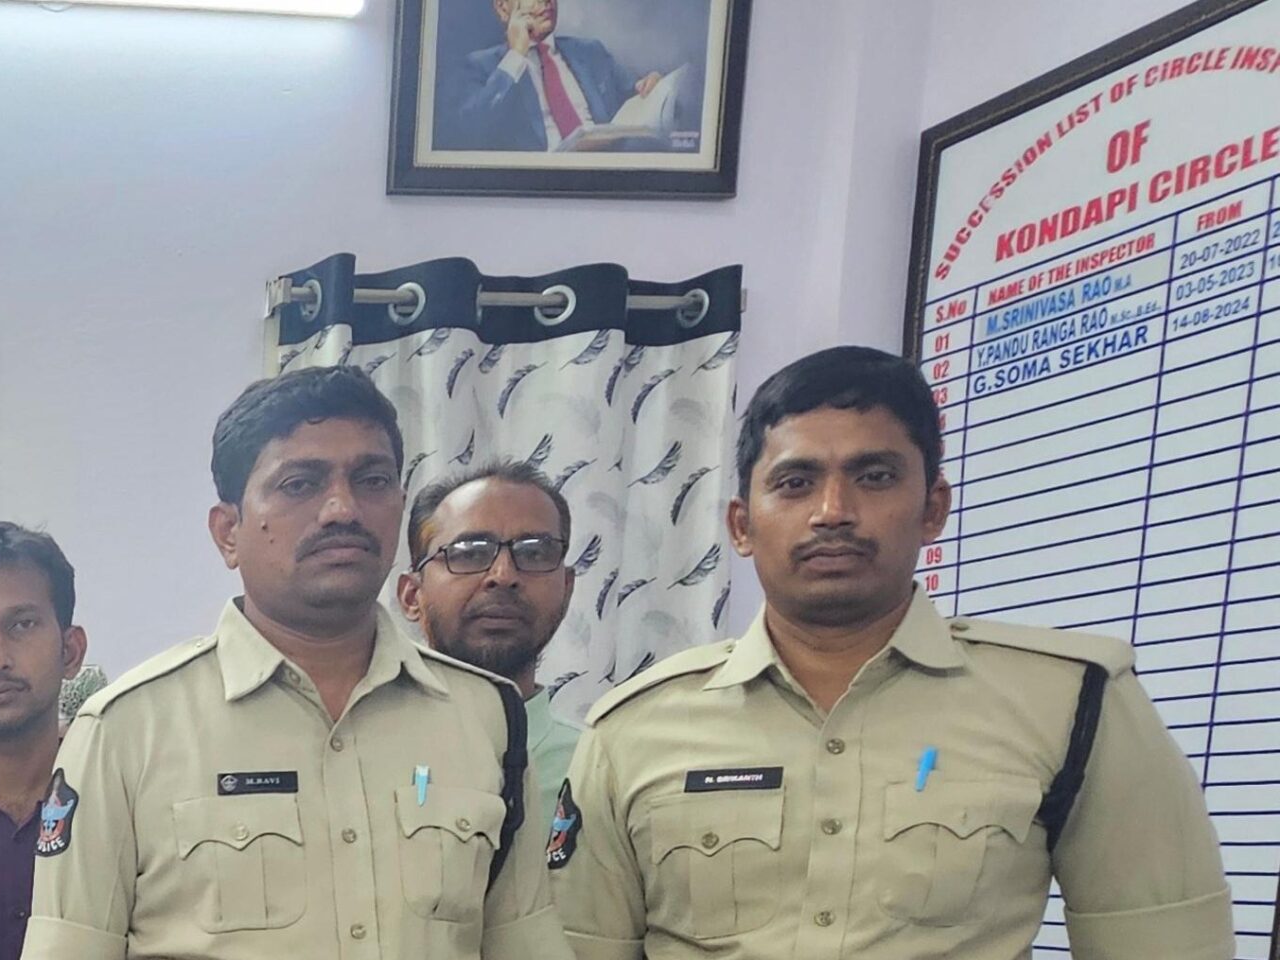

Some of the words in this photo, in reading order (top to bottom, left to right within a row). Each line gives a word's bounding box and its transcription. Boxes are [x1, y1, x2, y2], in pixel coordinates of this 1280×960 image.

[933, 132, 1054, 281] SUCCESSION
[1055, 92, 1104, 138] LIST
[1109, 73, 1140, 104] OF
[1143, 47, 1231, 87] CIRCLE
[995, 181, 1140, 263] KONDAPI
[1148, 125, 1280, 205] CIRCLE
[1106, 119, 1152, 174] OF
[934, 333, 950, 354] 01
[985, 291, 1077, 336] M.SRINIVASA
[1081, 275, 1112, 305] RAO
[1179, 229, 1261, 271] 20-07-2022
[986, 284, 1024, 307] NAME
[1027, 273, 1046, 292] OF
[1048, 260, 1073, 287] THE
[1074, 232, 1156, 276] INSPECTOR
[1196, 200, 1243, 233] FROM
[932, 361, 951, 380] 02
[976, 337, 1030, 368] Y.PANDU
[1031, 320, 1077, 350] RANGA
[1080, 307, 1109, 331] RAO
[1176, 261, 1256, 301] 03-05-2023
[973, 356, 1052, 395] G.SOMA
[1059, 325, 1150, 369] SEKHAR
[925, 574, 939, 592] 10
[926, 546, 942, 565] 09
